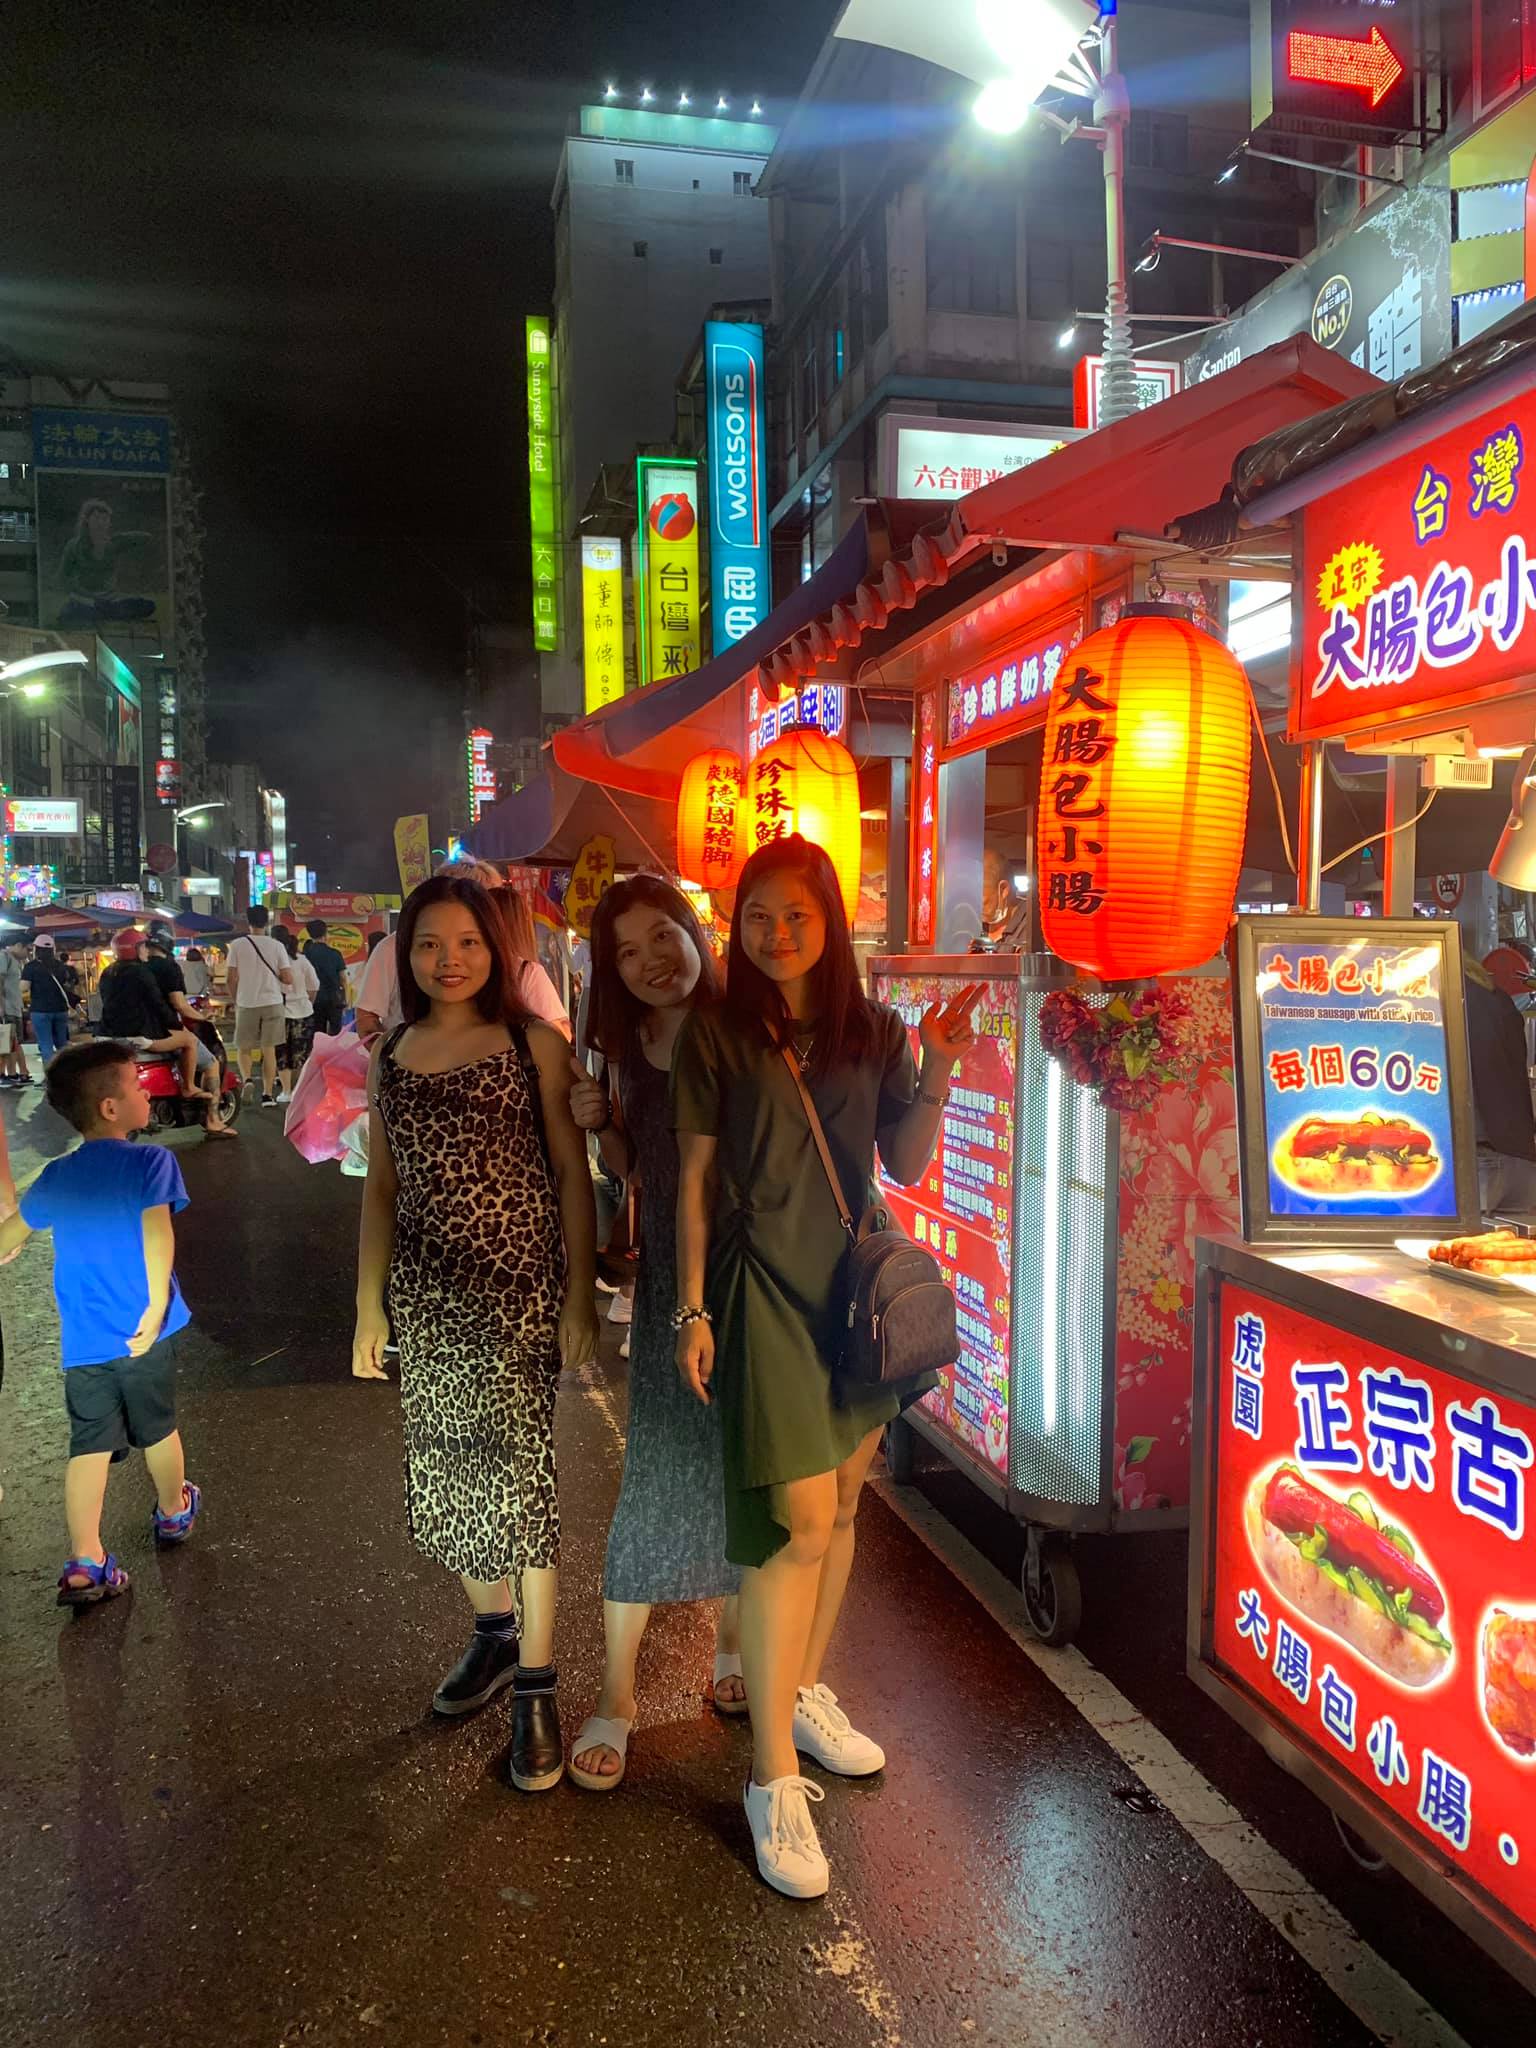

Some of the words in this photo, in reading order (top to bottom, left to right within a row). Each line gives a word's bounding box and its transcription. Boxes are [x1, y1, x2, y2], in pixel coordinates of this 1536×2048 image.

[1318, 304, 1346, 342] No.1
[1200, 346, 1241, 381] Santen
[532, 360, 545, 432] Sunnyside
[42, 445, 107, 461] FALUN
[111, 447, 161, 463] DAFA
[533, 431, 547, 473] Hotel
[725, 373, 746, 521] watsons
[1003, 453, 1040, 467] 台湾の
[1412, 428, 1521, 542] 台灣
[1330, 556, 1369, 600] 正宗
[962, 642, 1062, 727] 珍珠鮮奶茶
[755, 757, 796, 847] 珍珠鮮
[1047, 665, 1118, 915] 大腸包小腸
[1265, 953, 1432, 998] 大腸包小
[1264, 1003, 1315, 1019] Taiwanese
[1317, 1006, 1356, 1021] sausage
[1357, 1006, 1380, 1021] with
[1414, 1008, 1435, 1022] rice
[1269, 1045, 1442, 1094] 每個60元
[998, 1100, 1009, 1117] 55
[998, 1136, 1009, 1153] 55
[997, 1171, 1008, 1188] 55
[996, 1207, 1008, 1224] 55
[1232, 1312, 1265, 1440] 虎園
[1291, 1359, 1535, 1540] 正宗古
[1234, 1588, 1472, 1851] 大腸包小腸
